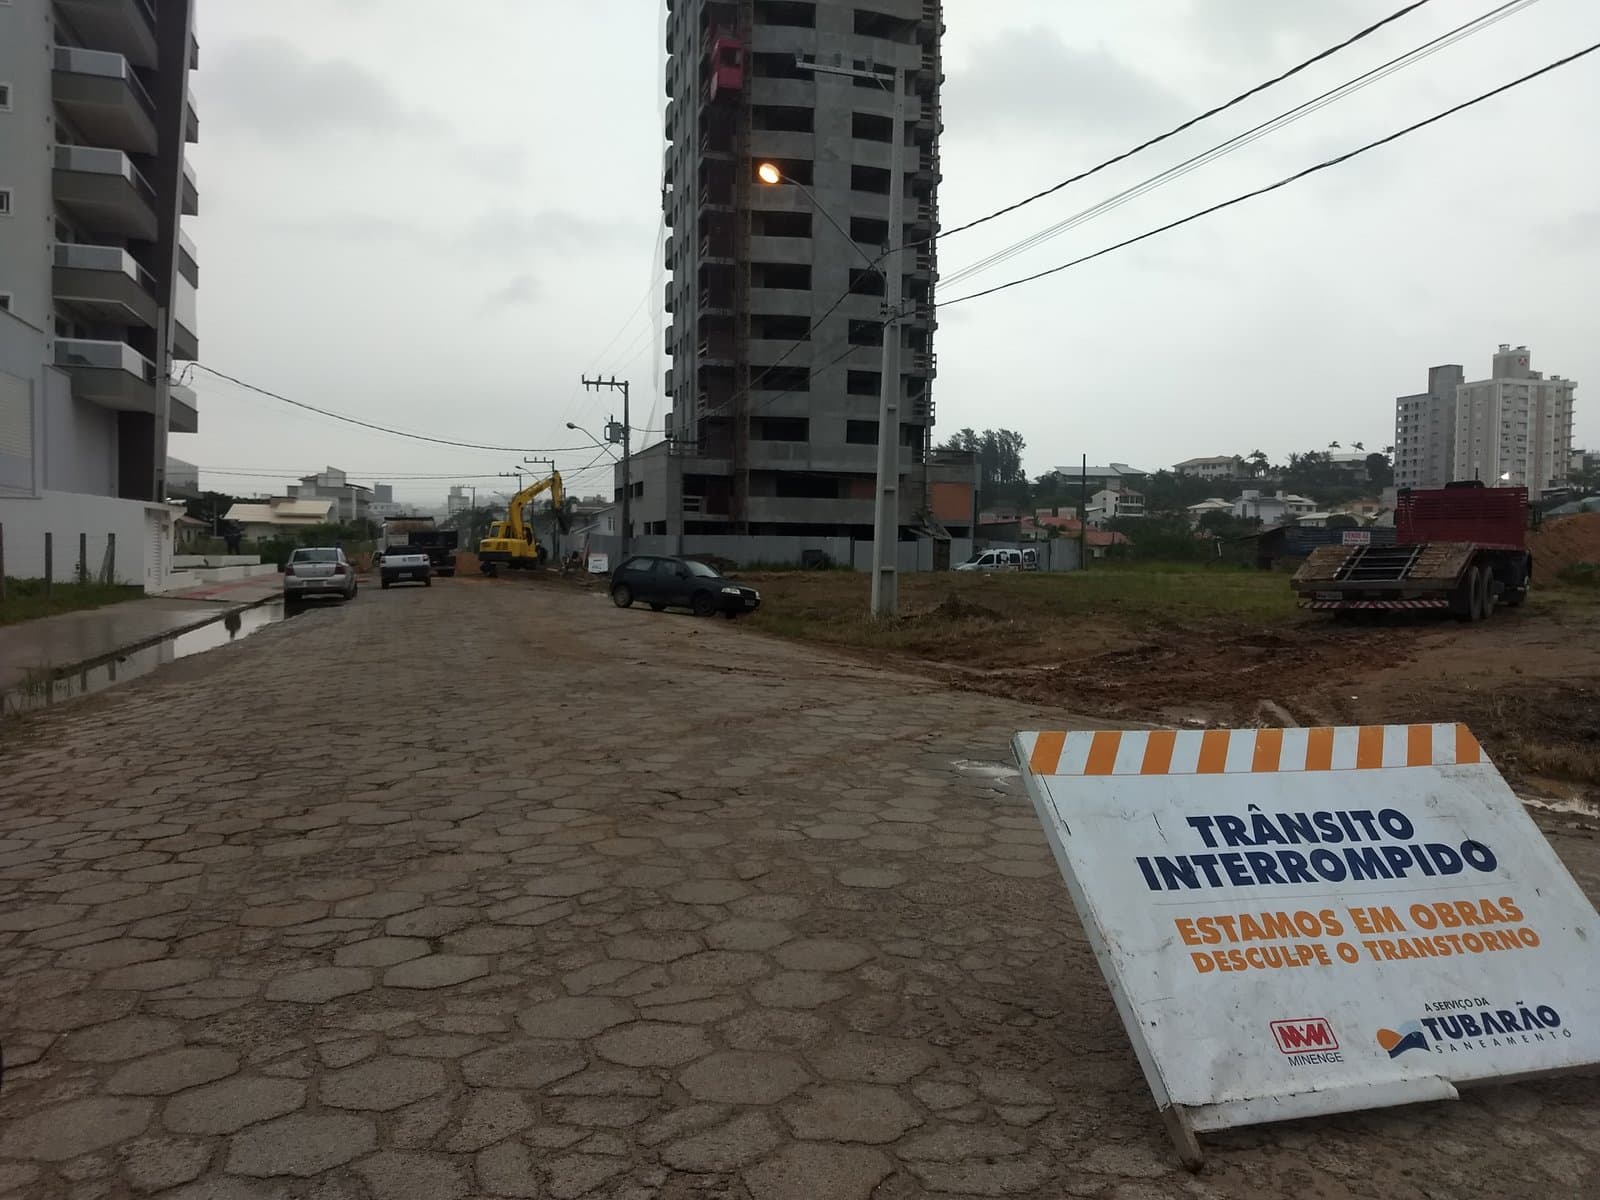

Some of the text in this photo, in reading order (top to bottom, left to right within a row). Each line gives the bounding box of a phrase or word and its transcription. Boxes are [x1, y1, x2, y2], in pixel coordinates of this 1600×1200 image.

[1186, 804, 1415, 848] TRÂNSITO
[1136, 839, 1498, 891] INTERROMPIDO
[1174, 897, 1524, 946] ESTAMOS EM OBRAS
[1190, 927, 1541, 974] DESCULPE O TRANSTORNO
[1421, 1001, 1561, 1042] TUBARÃO
[1424, 997, 1490, 1013] A SERVIÇO DA
[1288, 1052, 1344, 1067] MINENGE
[1435, 1029, 1573, 1054] SANEAMENTO
